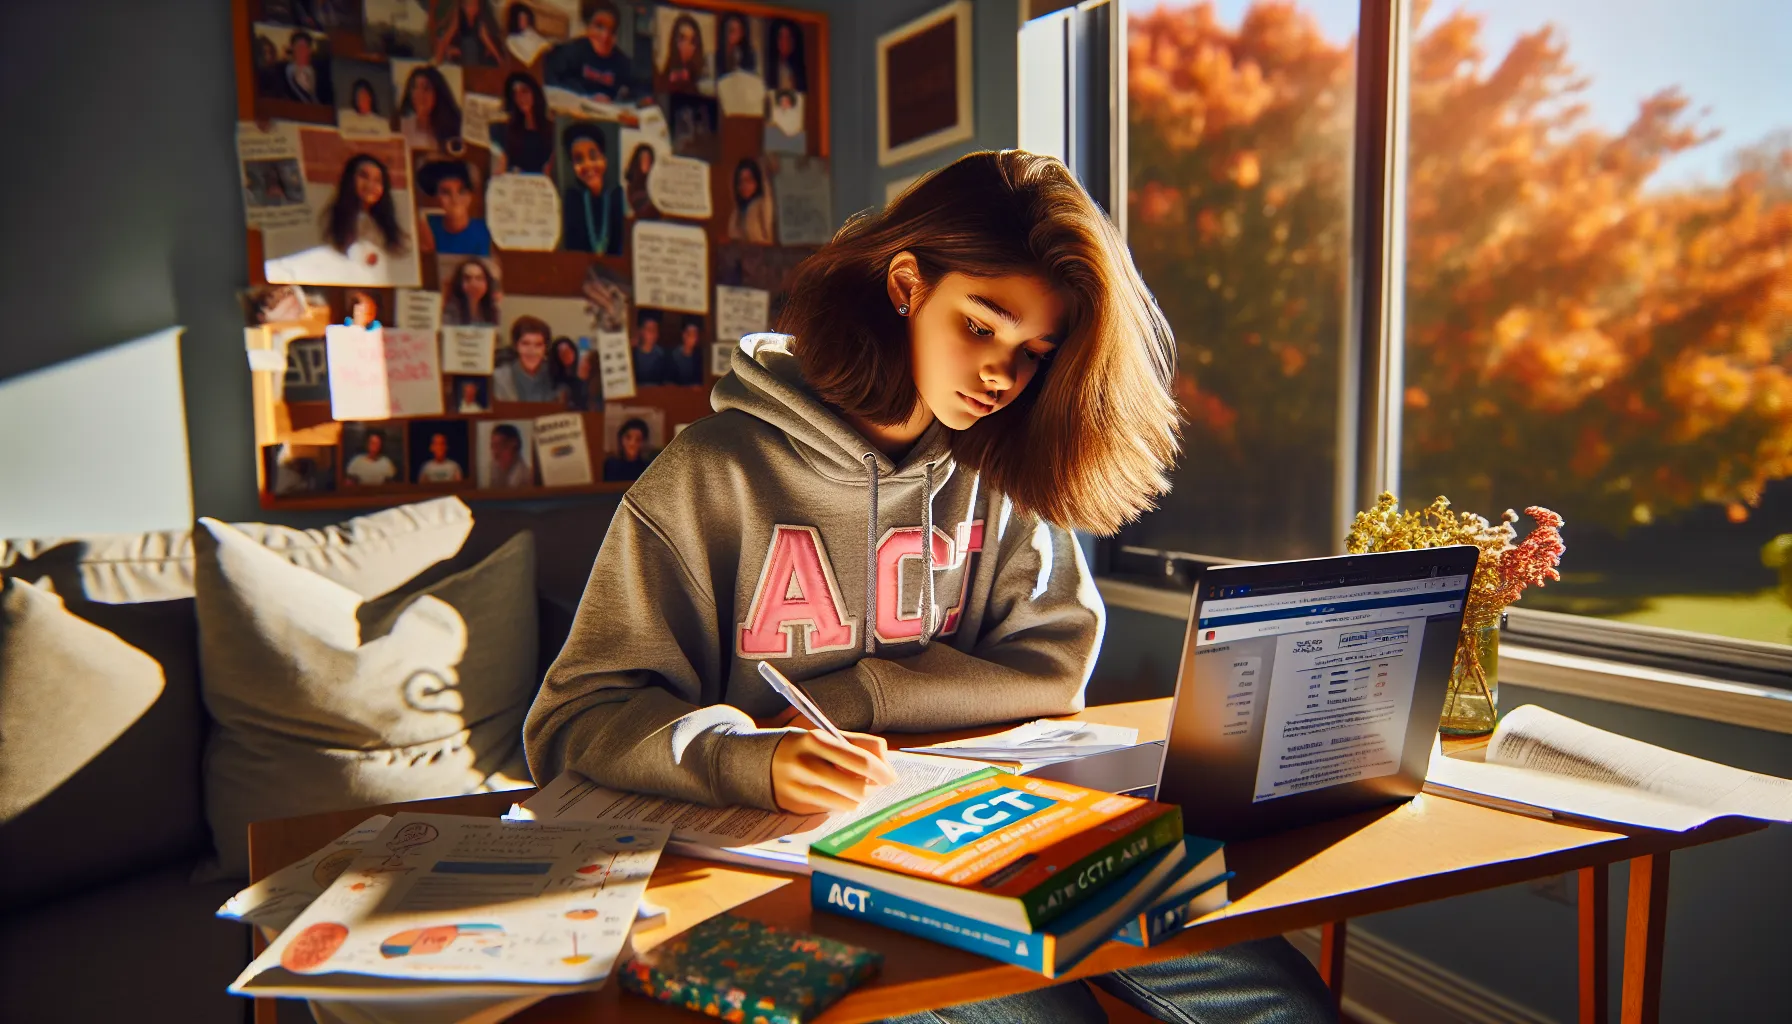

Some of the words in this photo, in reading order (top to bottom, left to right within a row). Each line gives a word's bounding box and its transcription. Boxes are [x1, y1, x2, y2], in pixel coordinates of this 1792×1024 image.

[736, 519, 985, 659] ACT
[935, 790, 1036, 844] ACT
[827, 882, 871, 913] ACT
